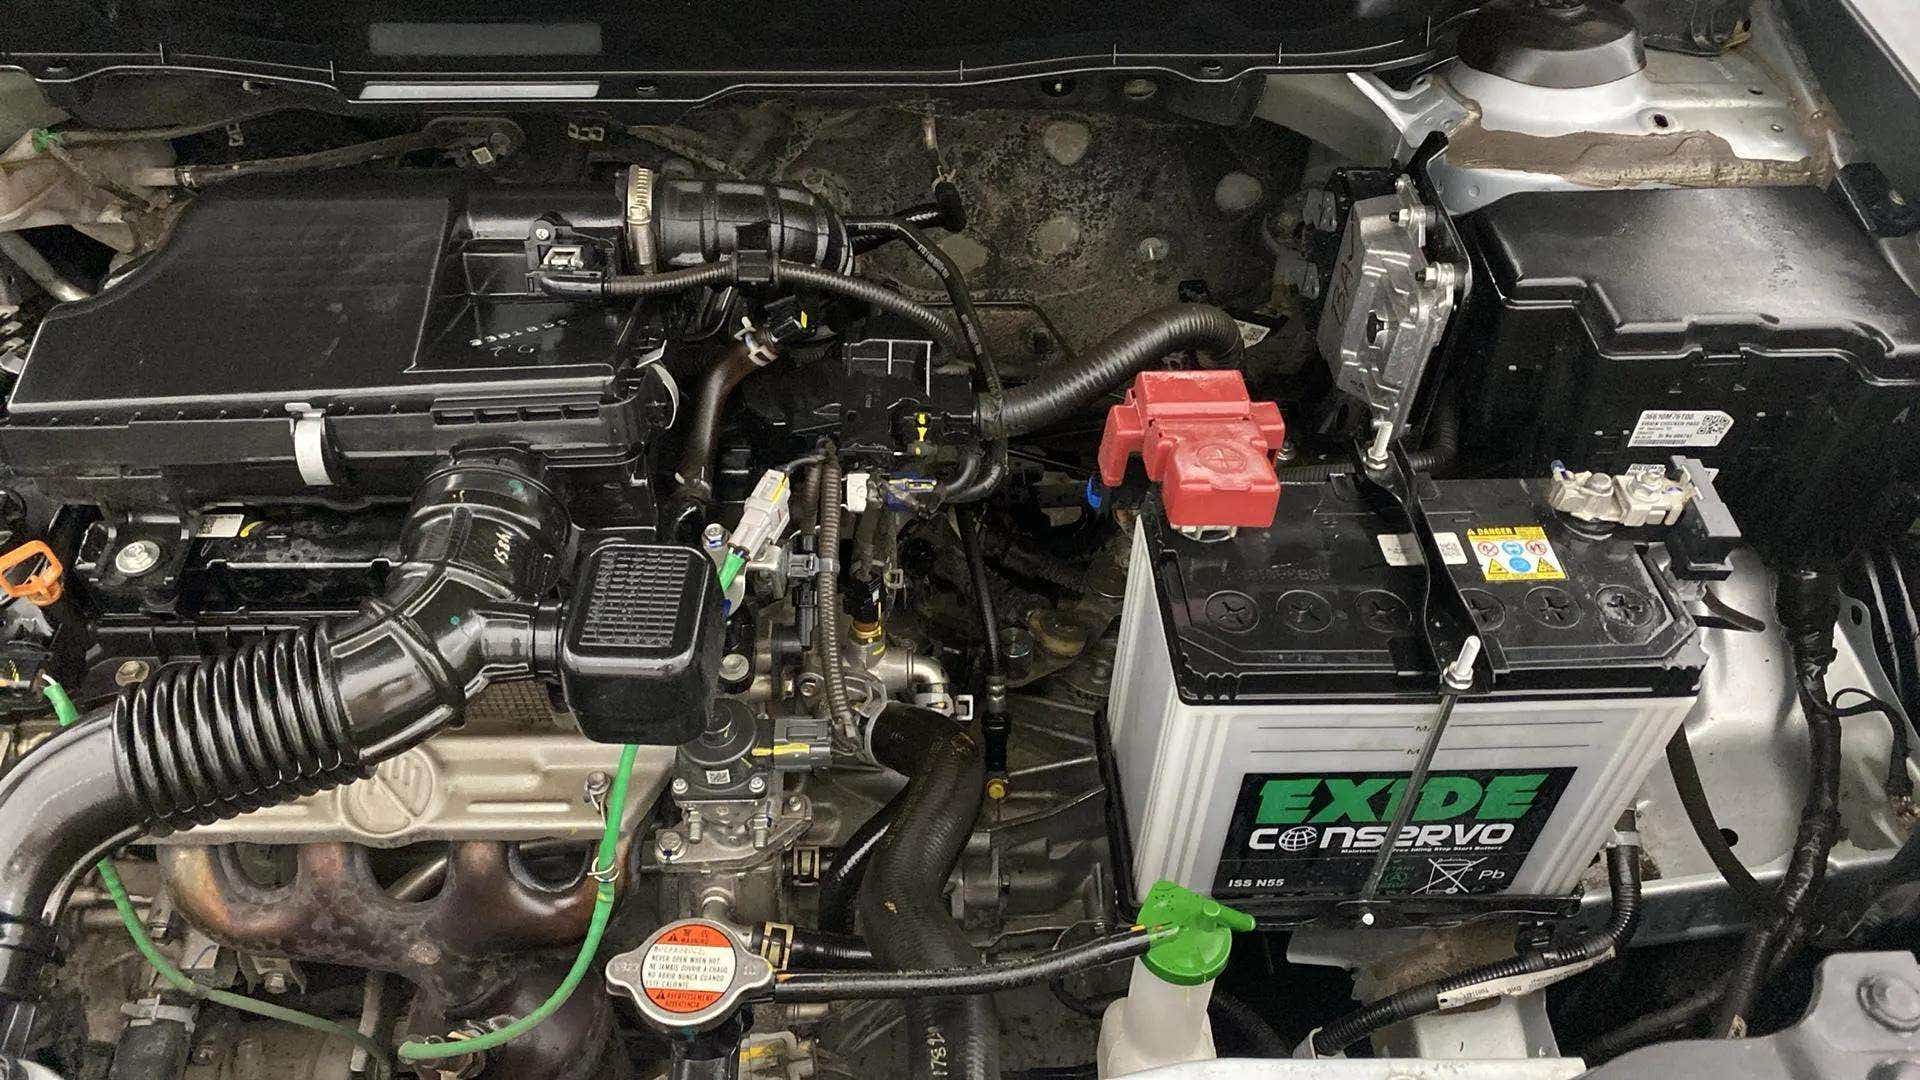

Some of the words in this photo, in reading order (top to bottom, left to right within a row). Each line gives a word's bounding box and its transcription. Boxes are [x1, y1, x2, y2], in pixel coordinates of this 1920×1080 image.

[1477, 527, 1513, 536] DANGER
[1255, 773, 1550, 824] EXIDE
[1478, 869, 1505, 881] Pb
[1228, 879, 1252, 888] ISS
[1256, 878, 1285, 887] N55
[651, 955, 670, 963] NEVER
[673, 956, 687, 964] OPEN
[690, 957, 707, 965] WHEN
[659, 963, 679, 972] JAMAIS
